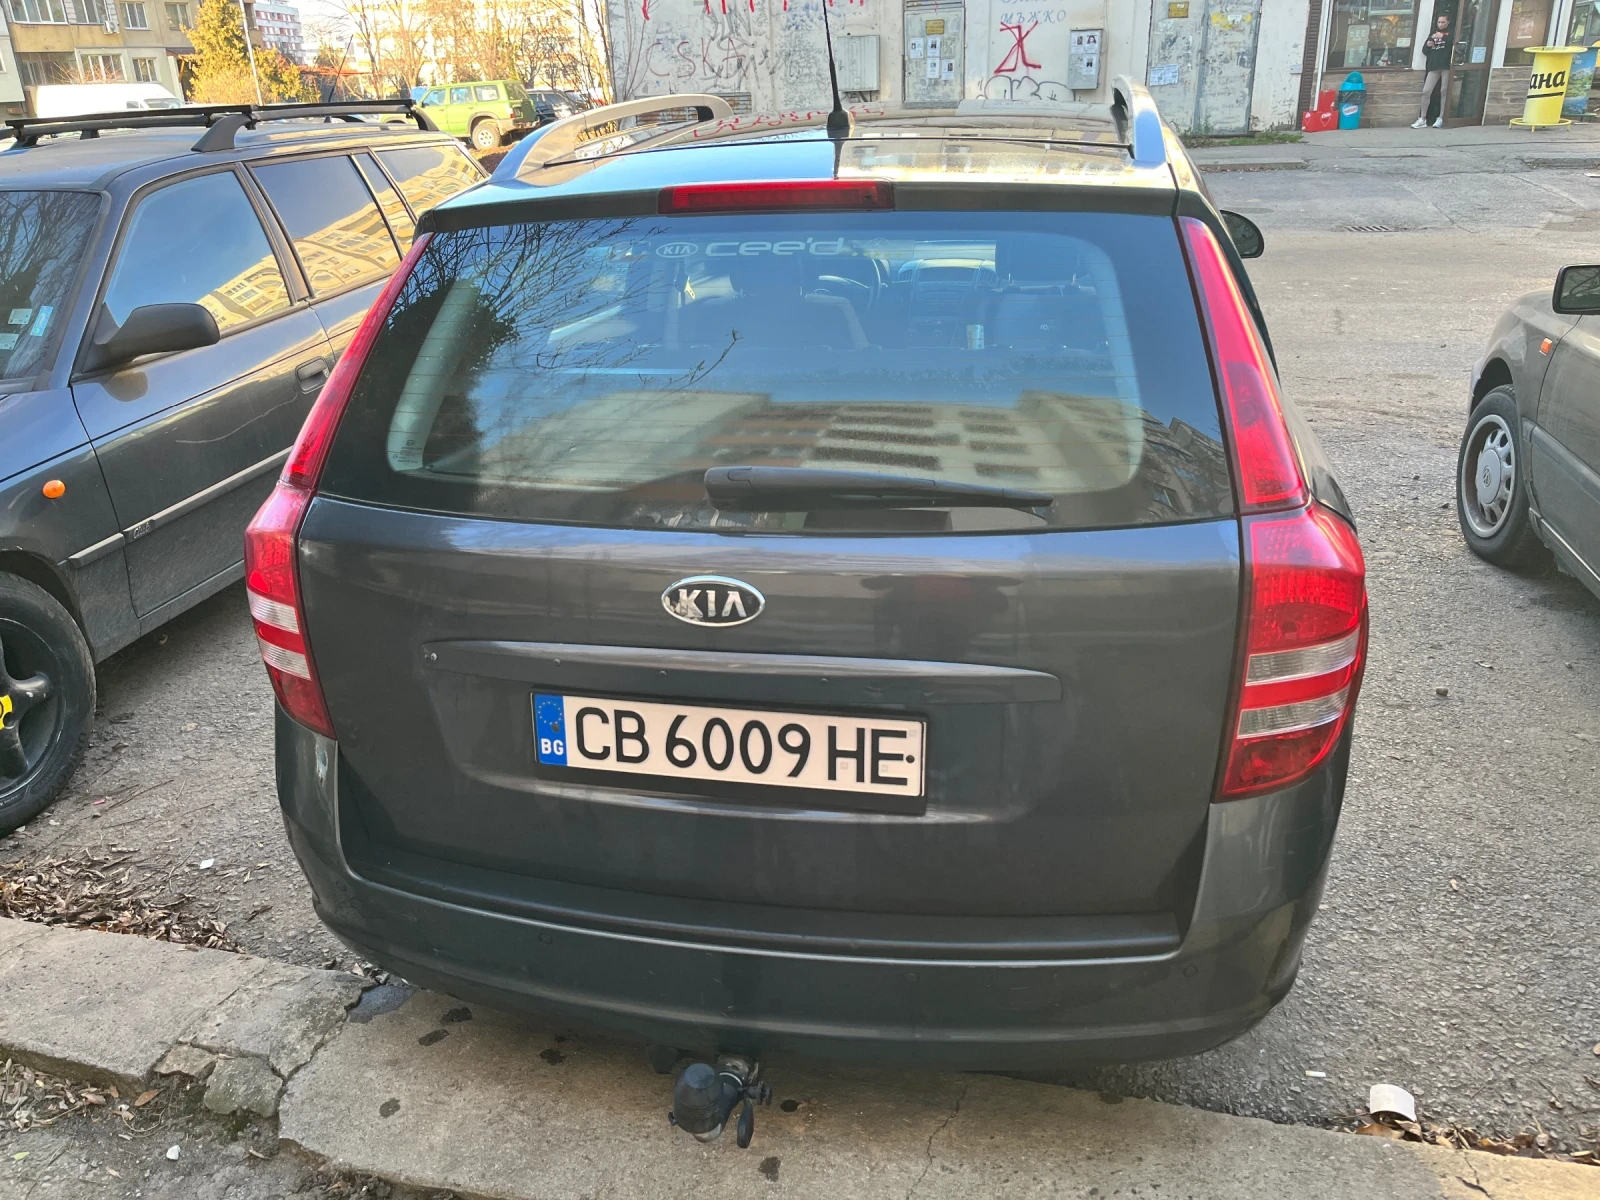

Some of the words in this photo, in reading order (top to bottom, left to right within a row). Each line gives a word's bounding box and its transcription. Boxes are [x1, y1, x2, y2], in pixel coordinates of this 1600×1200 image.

[646, 36, 747, 78] CSKA
[662, 244, 693, 255] KIA
[705, 237, 845, 257] cee'd
[676, 588, 748, 619] KIA
[540, 738, 565, 757] BG
[575, 706, 650, 764] CB
[665, 714, 812, 778] 6009
[827, 725, 908, 786] HE
